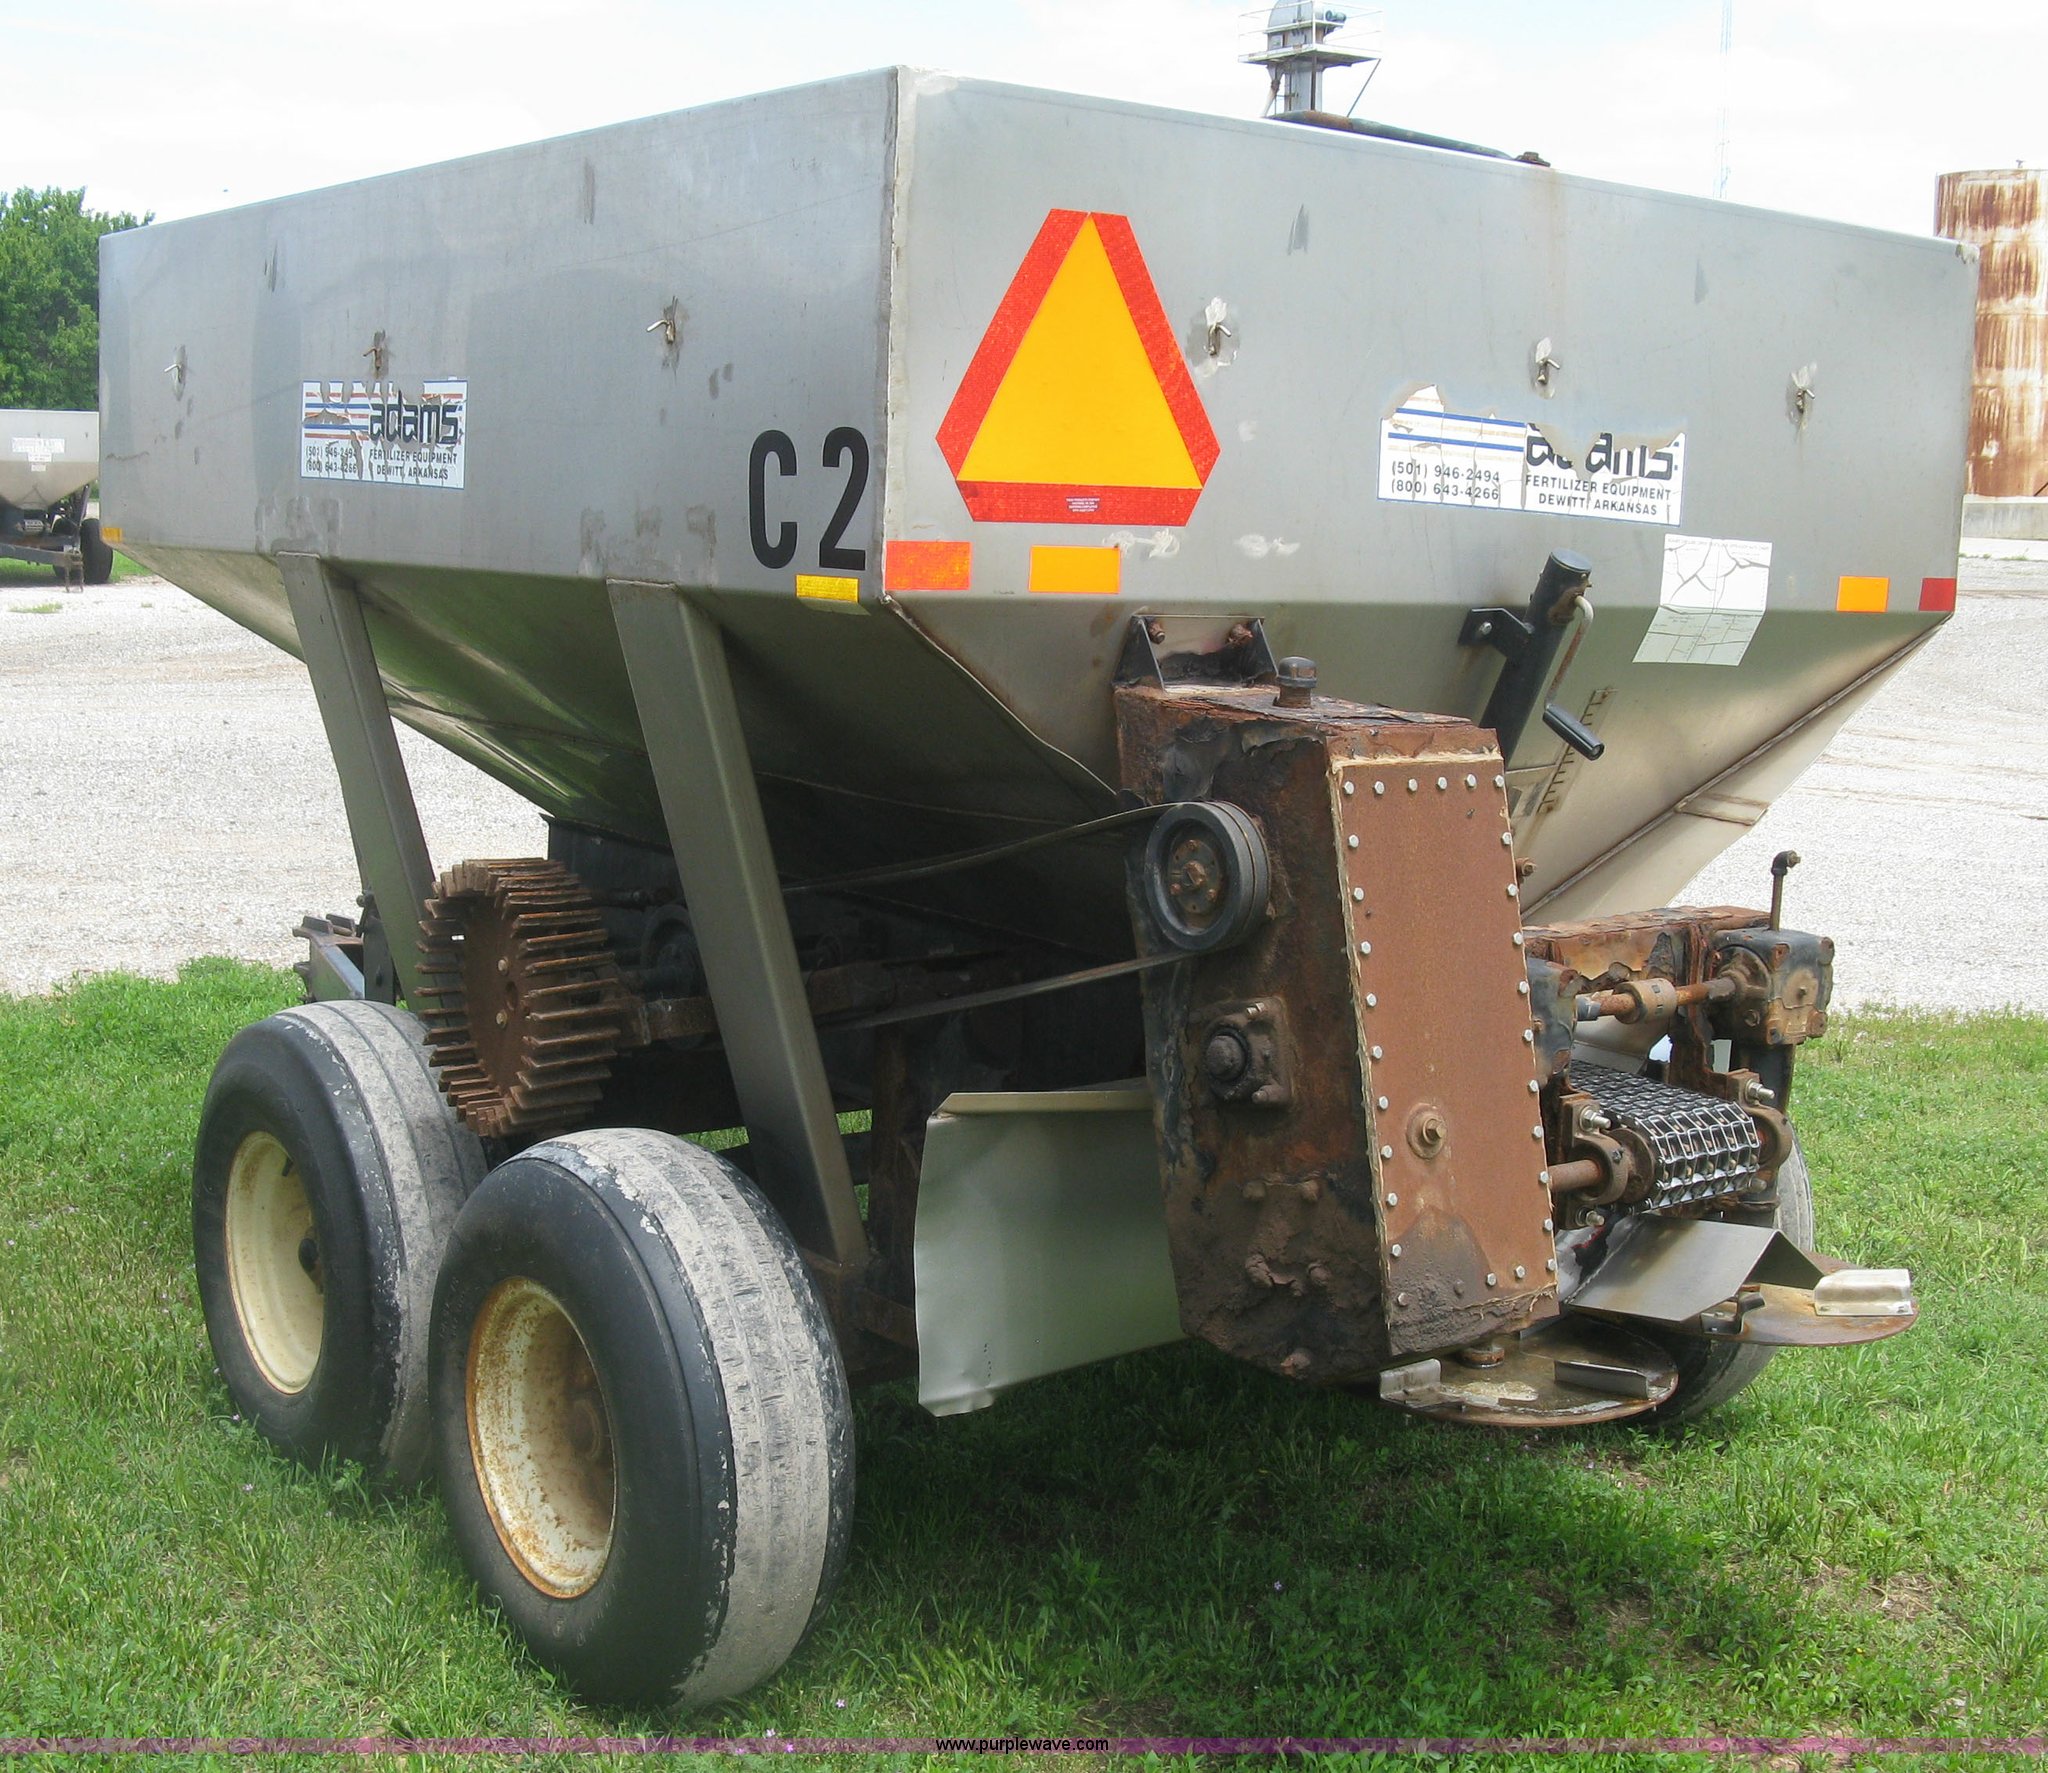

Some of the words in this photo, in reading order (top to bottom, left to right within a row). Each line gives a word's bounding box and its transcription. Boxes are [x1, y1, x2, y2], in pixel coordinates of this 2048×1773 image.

[370, 390, 459, 444] adams
[1392, 461, 1428, 478] (501)
[1391, 479, 1427, 495] (800)
[1526, 475, 1597, 493] FERTILIZER
[1602, 483, 1671, 500] EQUIPMENT
[1594, 500, 1657, 515] ARKANSAS
